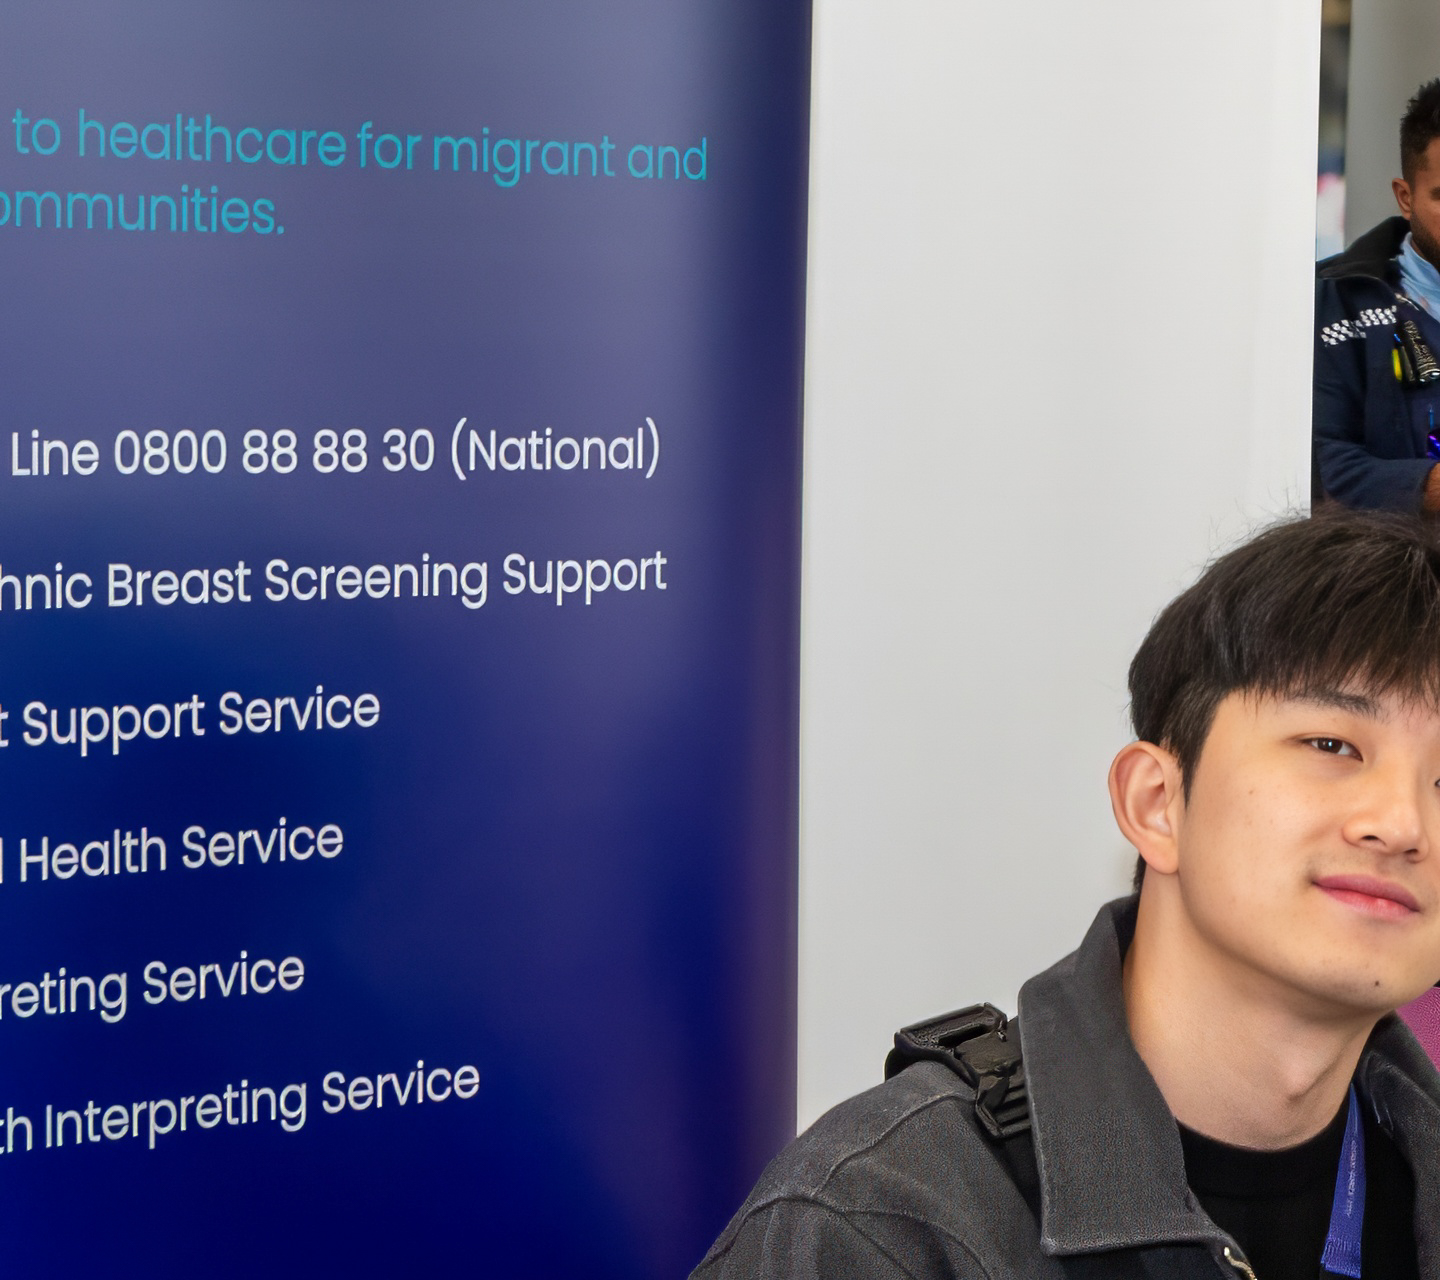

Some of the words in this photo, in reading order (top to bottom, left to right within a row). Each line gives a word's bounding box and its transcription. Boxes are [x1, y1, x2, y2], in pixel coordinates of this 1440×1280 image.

[13, 111, 61, 155] to
[79, 108, 346, 168] healthcare
[357, 121, 423, 170] for
[433, 128, 615, 188] migrant
[628, 137, 708, 181] and
[11, 429, 99, 477] Line
[114, 429, 228, 475] 0800
[242, 429, 298, 474] 88
[312, 429, 368, 474] 88
[382, 429, 436, 472] 30
[451, 417, 661, 481] (National)
[107, 558, 251, 608] Breast
[264, 553, 489, 609] Screening
[502, 551, 668, 607] Support
[22, 694, 205, 757] Support
[218, 685, 381, 737] Service
[20, 827, 166, 883] Health
[181, 817, 344, 869] Service
[143, 950, 305, 1005] Service
[46, 1080, 308, 1150] Interpreting
[321, 1060, 480, 1114] Service
